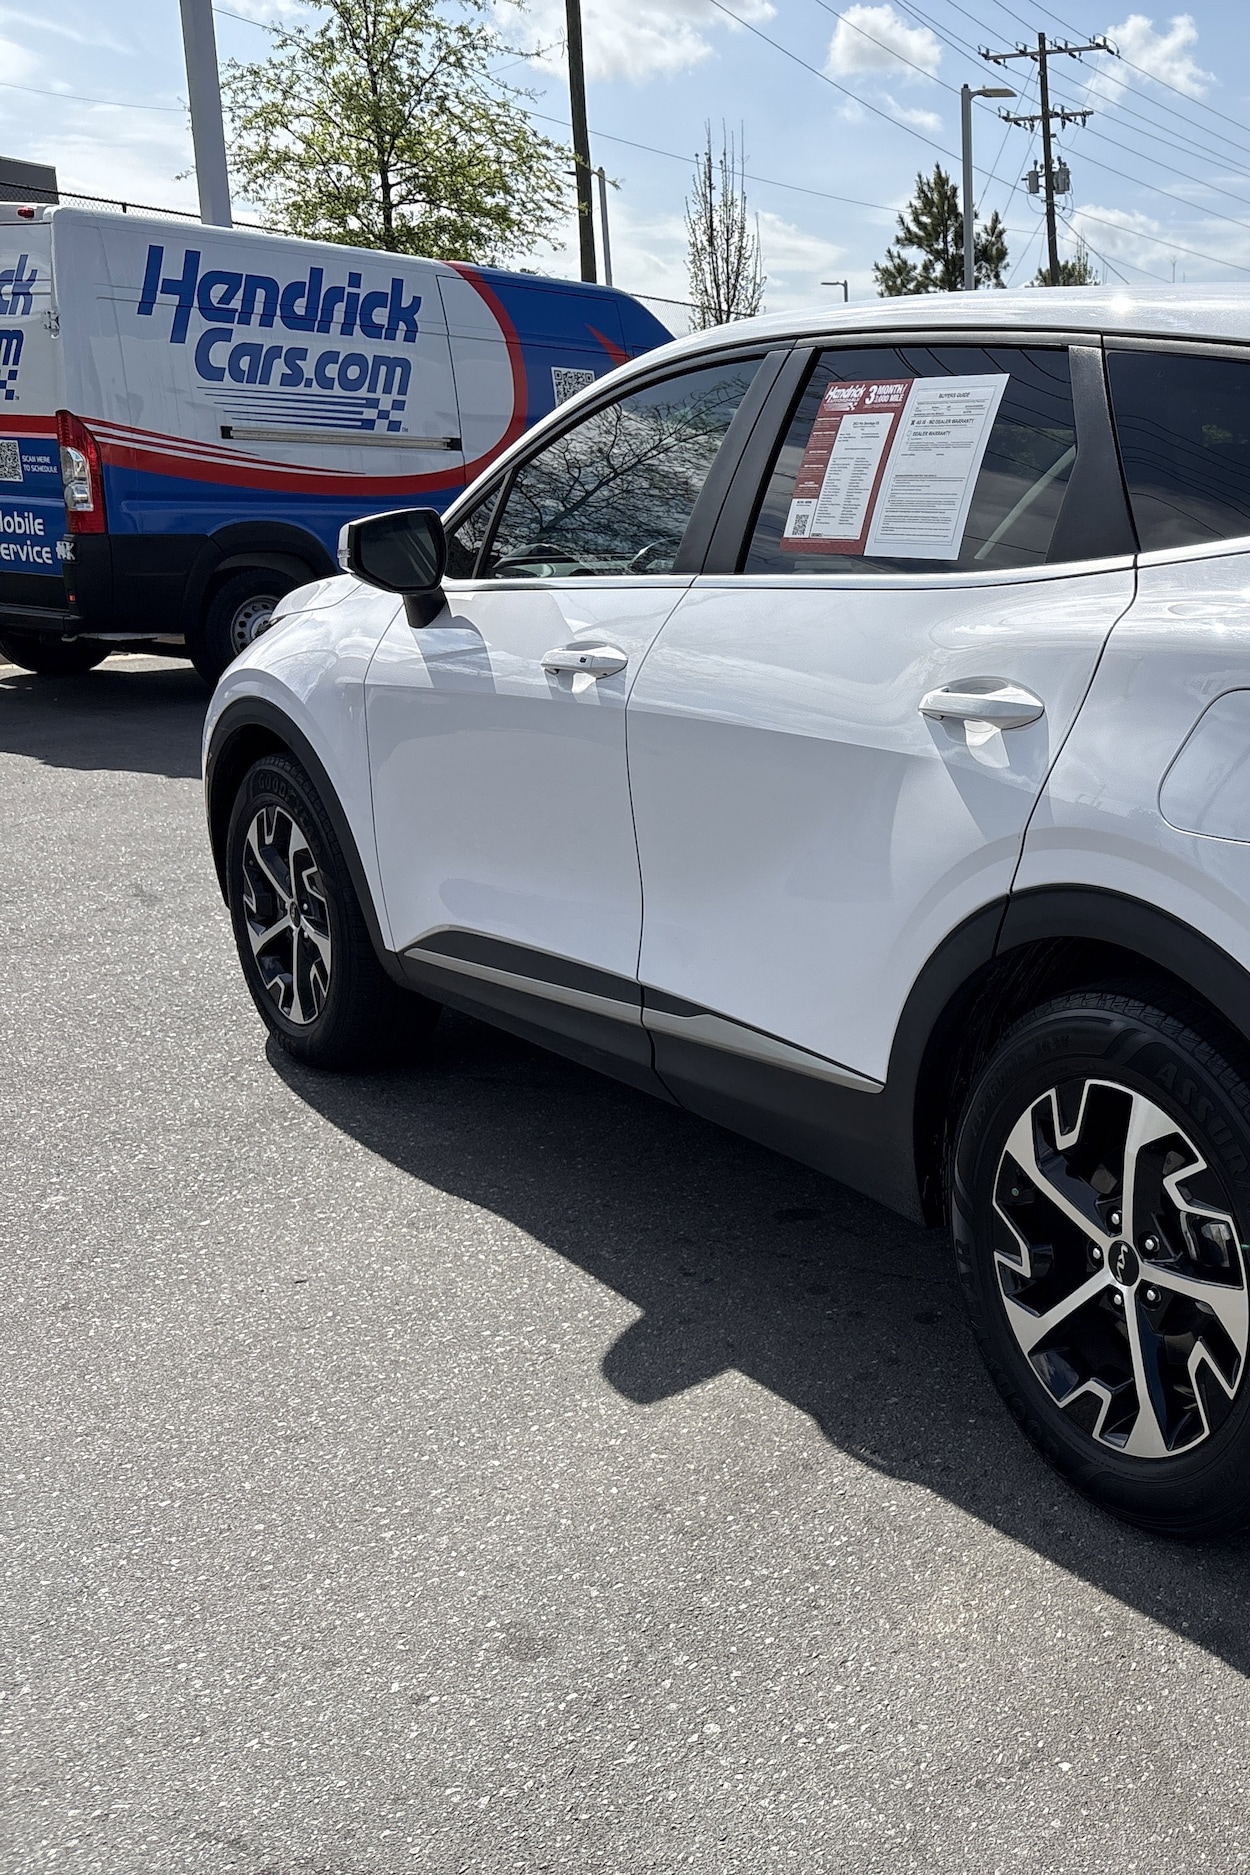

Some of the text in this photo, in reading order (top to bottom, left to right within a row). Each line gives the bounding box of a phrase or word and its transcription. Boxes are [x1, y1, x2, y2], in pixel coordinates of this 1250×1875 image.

[137, 244, 422, 344] Hendrick
[194, 327, 412, 396] Cars.com
[865, 385, 878, 405] 3
[22, 455, 50, 464] SCAN HERE
[23, 464, 58, 474] TO SCHEDULE
[0, 510, 45, 535] obile
[0, 540, 53, 564] ervice
